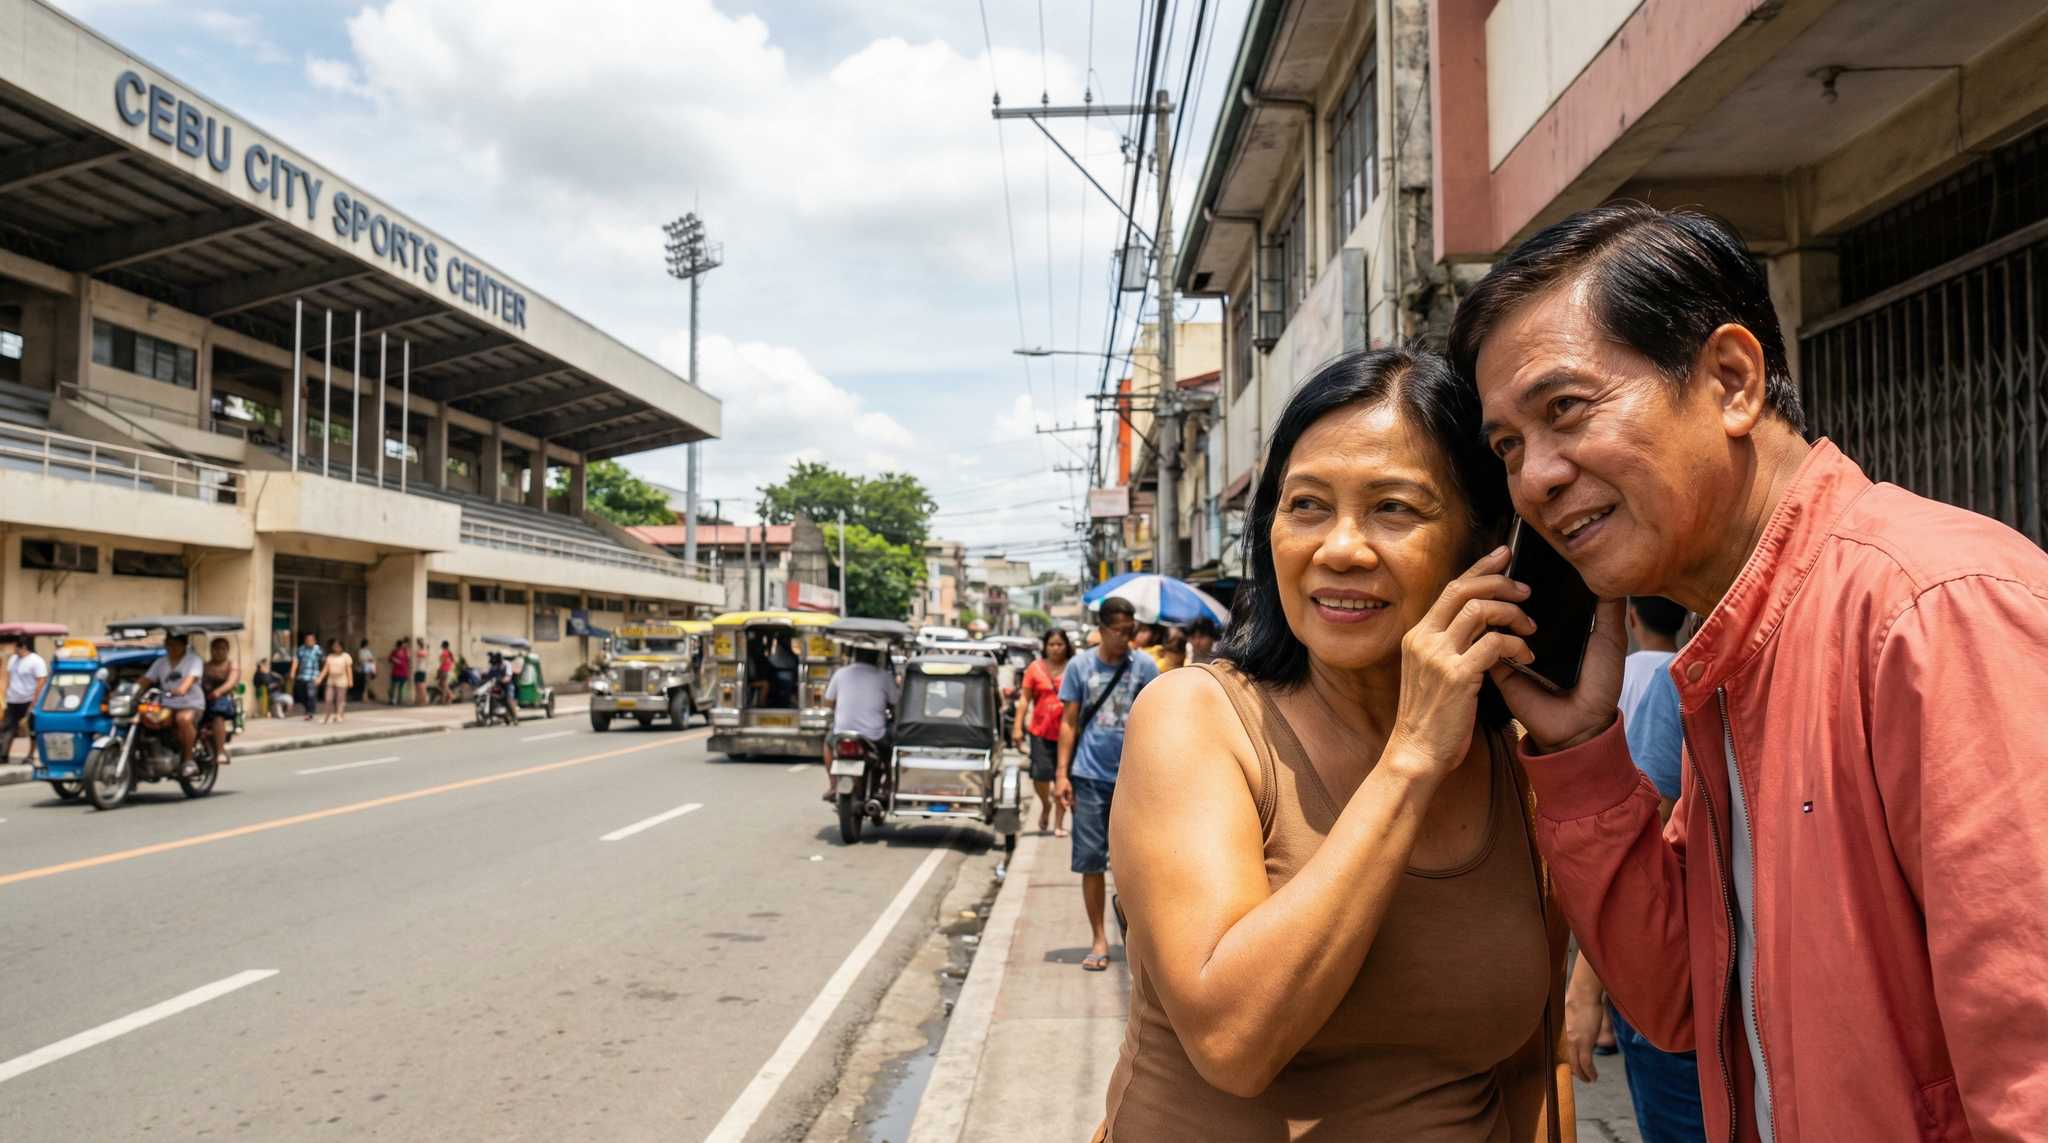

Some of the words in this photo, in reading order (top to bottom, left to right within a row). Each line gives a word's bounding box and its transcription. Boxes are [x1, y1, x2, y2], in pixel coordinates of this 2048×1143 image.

[115, 70, 232, 172] CEBU
[244, 144, 323, 220] CITY
[332, 191, 439, 283] SPORTS
[446, 257, 527, 330] CENTER
